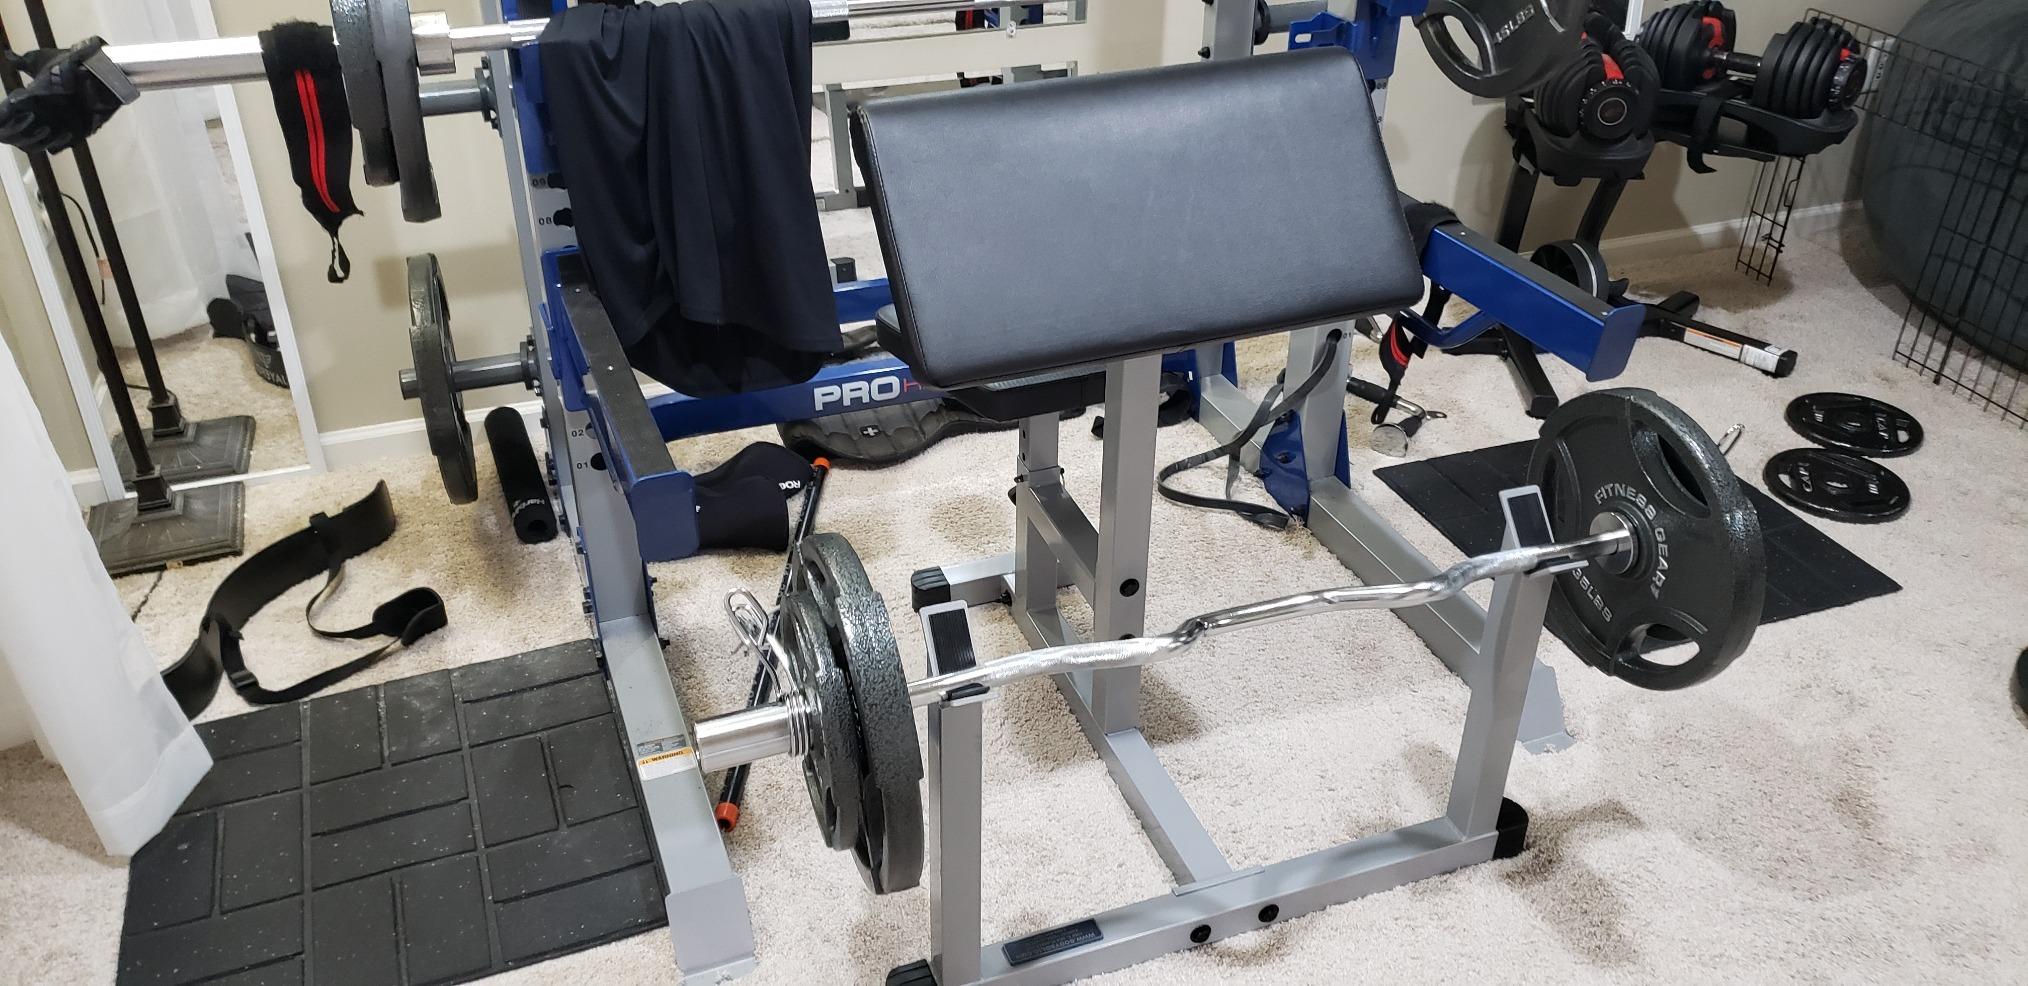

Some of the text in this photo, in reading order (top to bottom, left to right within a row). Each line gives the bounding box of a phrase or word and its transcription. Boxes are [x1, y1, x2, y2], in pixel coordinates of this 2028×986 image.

[1494, 4, 1535, 43] 15LBS
[538, 216, 552, 226] 08
[813, 375, 900, 411] PRO
[571, 429, 585, 438] 02
[576, 461, 589, 470] 01
[1594, 482, 1657, 521] FITNESS
[1572, 567, 1613, 623] 35LBS
